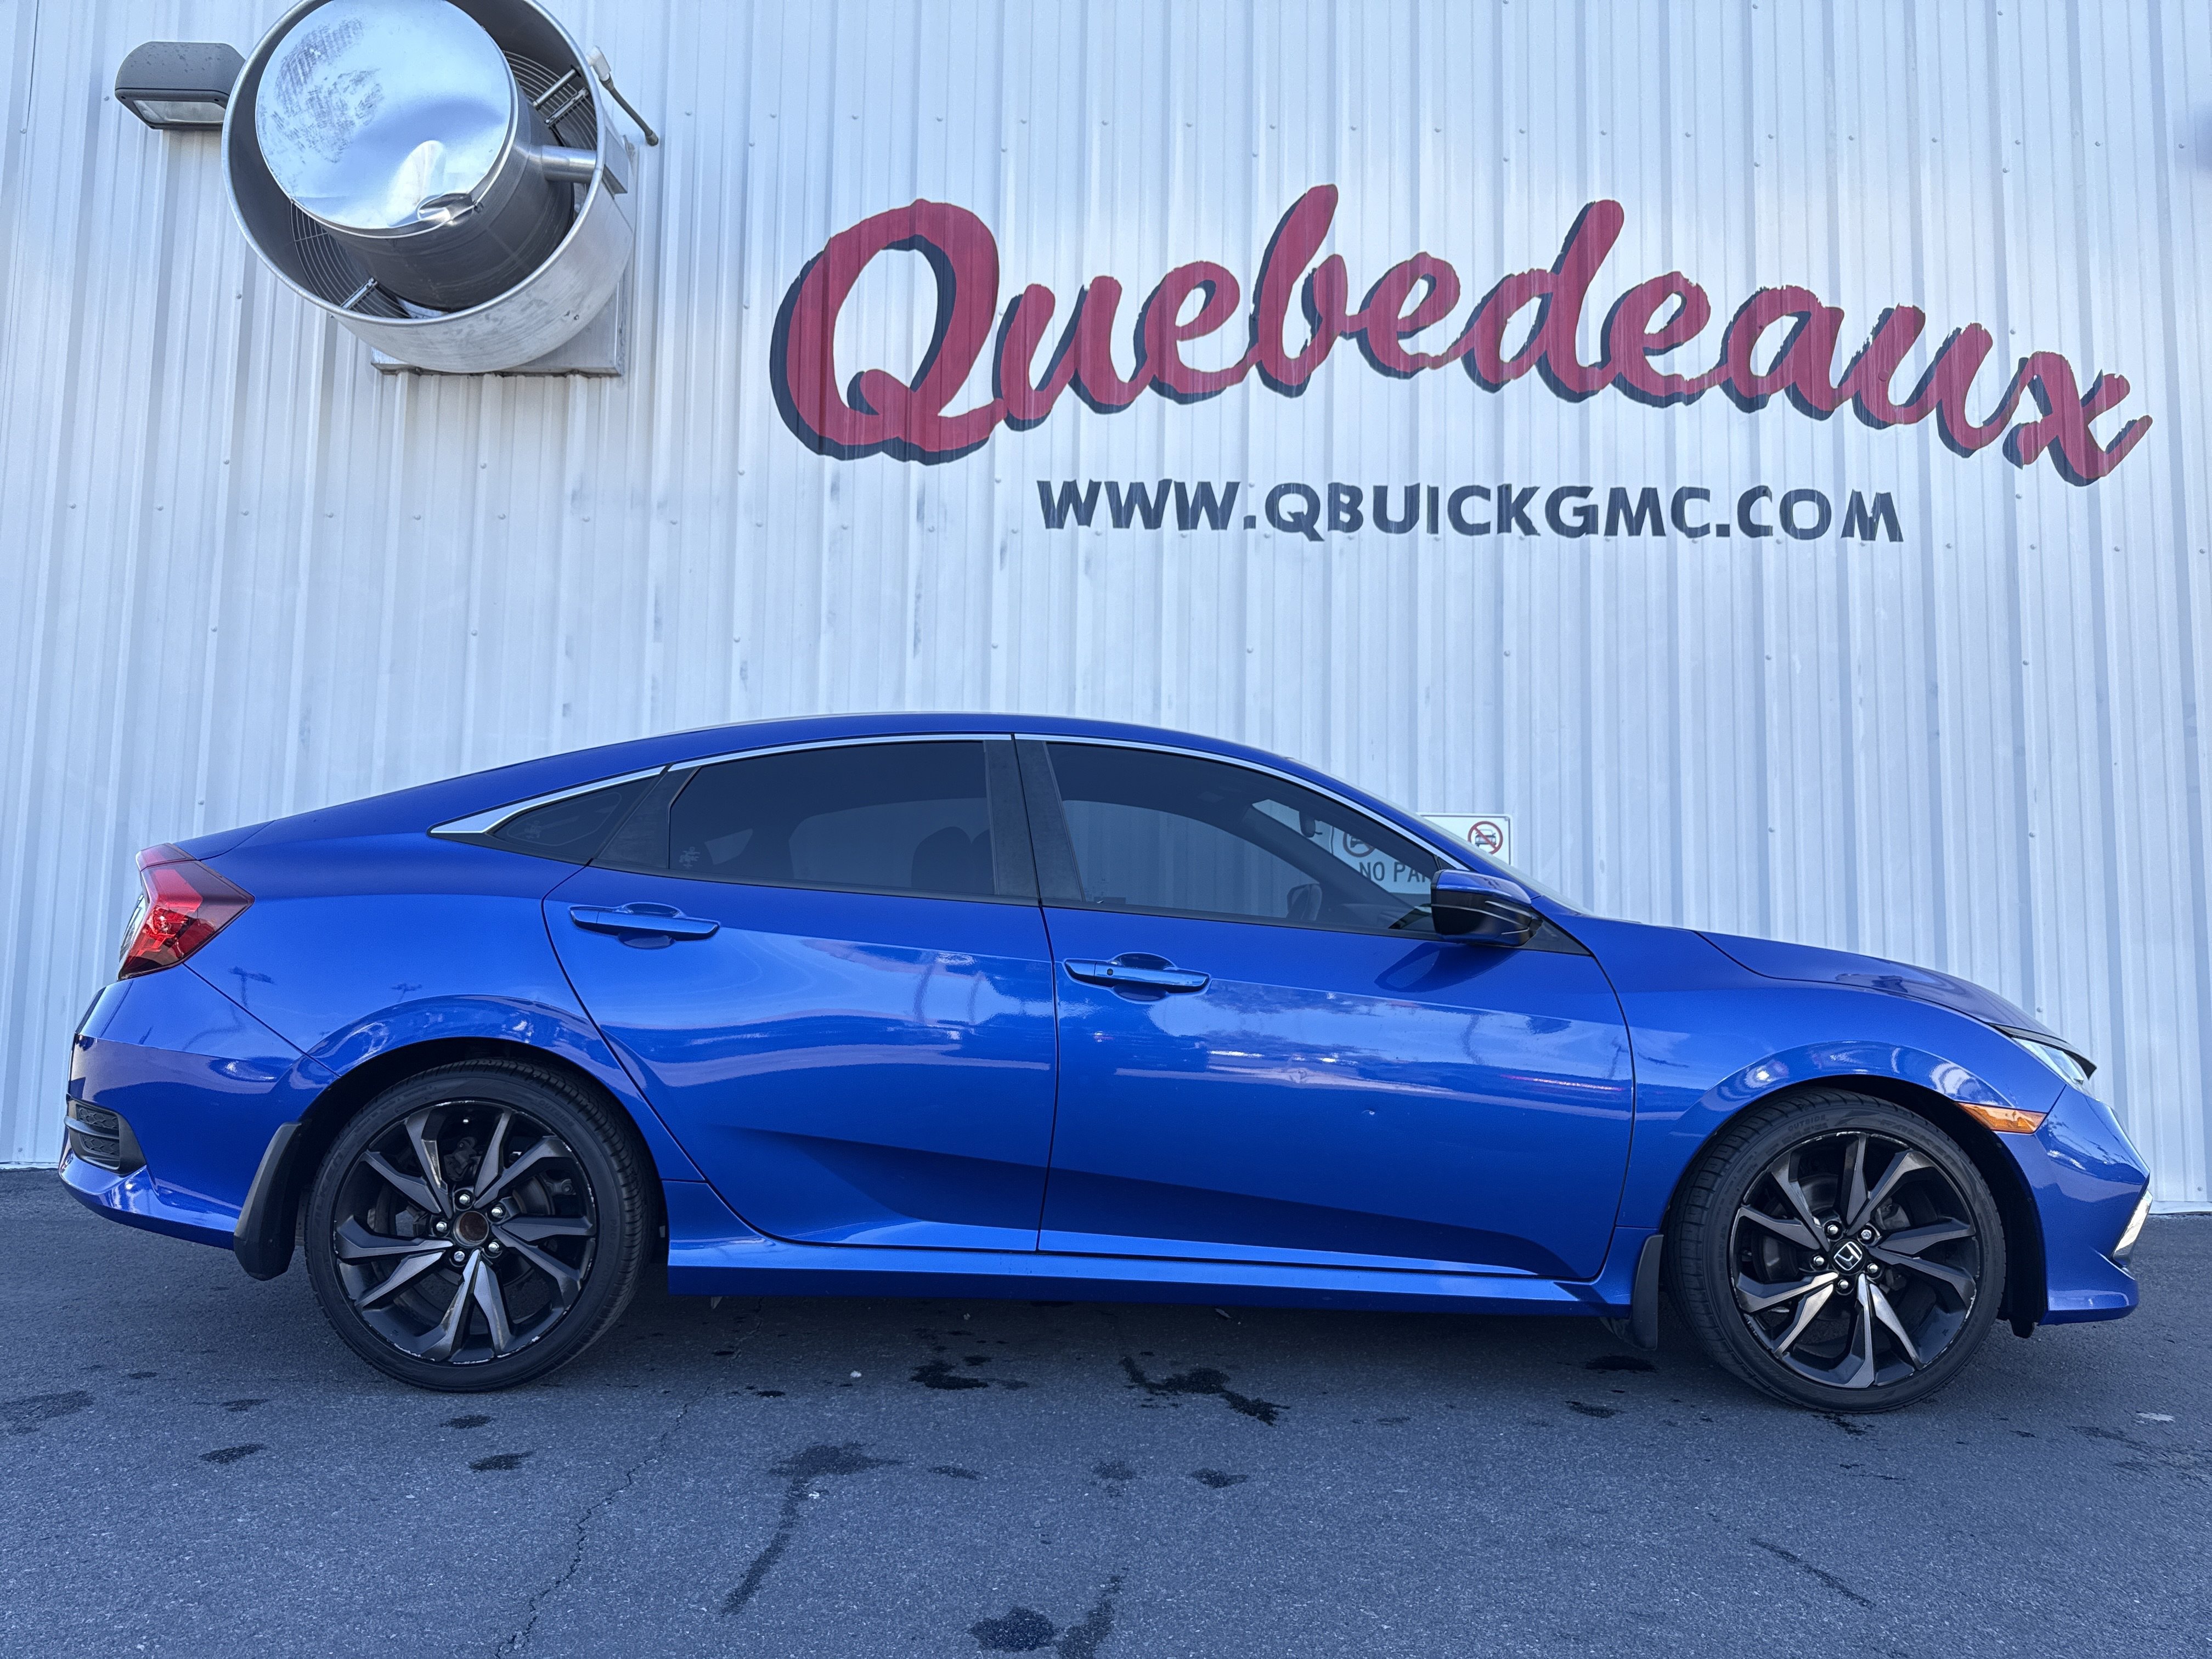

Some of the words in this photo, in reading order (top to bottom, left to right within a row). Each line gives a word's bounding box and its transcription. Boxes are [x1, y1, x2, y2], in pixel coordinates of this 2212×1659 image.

[770, 184, 2153, 487] Quebedeaux
[1036, 478, 1904, 542] WWW.QBUICKGMC.COM
[1359, 861, 1385, 881] NO
[1393, 861, 1425, 882] PA
[1788, 1114, 1826, 1132] OUTSIDE
